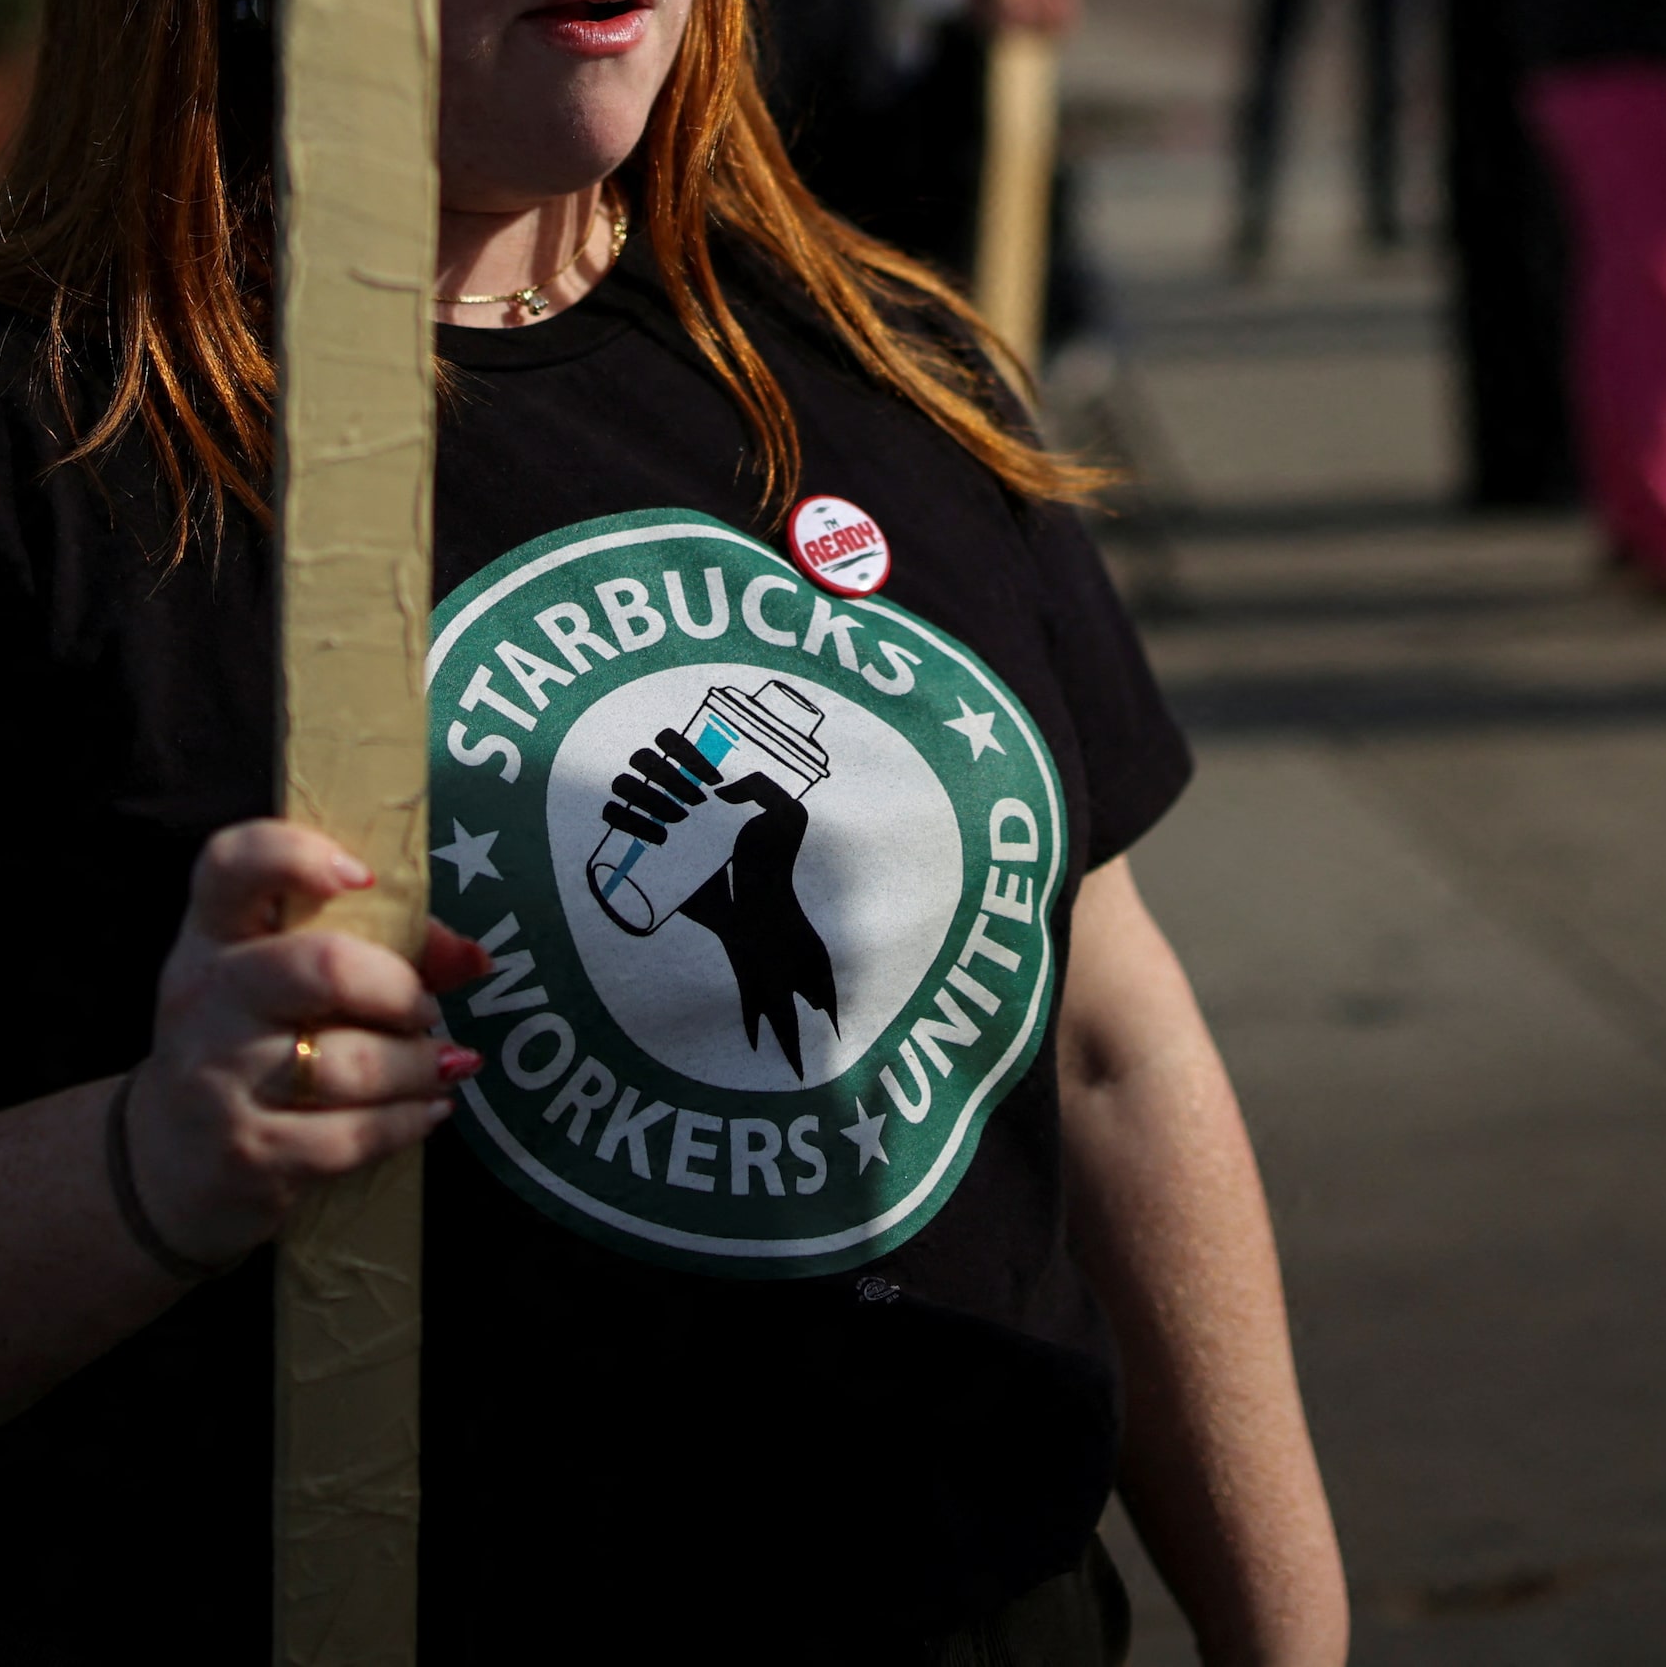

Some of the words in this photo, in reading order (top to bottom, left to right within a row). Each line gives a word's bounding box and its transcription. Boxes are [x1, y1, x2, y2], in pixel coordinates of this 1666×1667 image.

[447, 565, 923, 784] STARBUCKS
[466, 912, 829, 1197] WORKERS
[878, 795, 1040, 1125] UNITED
